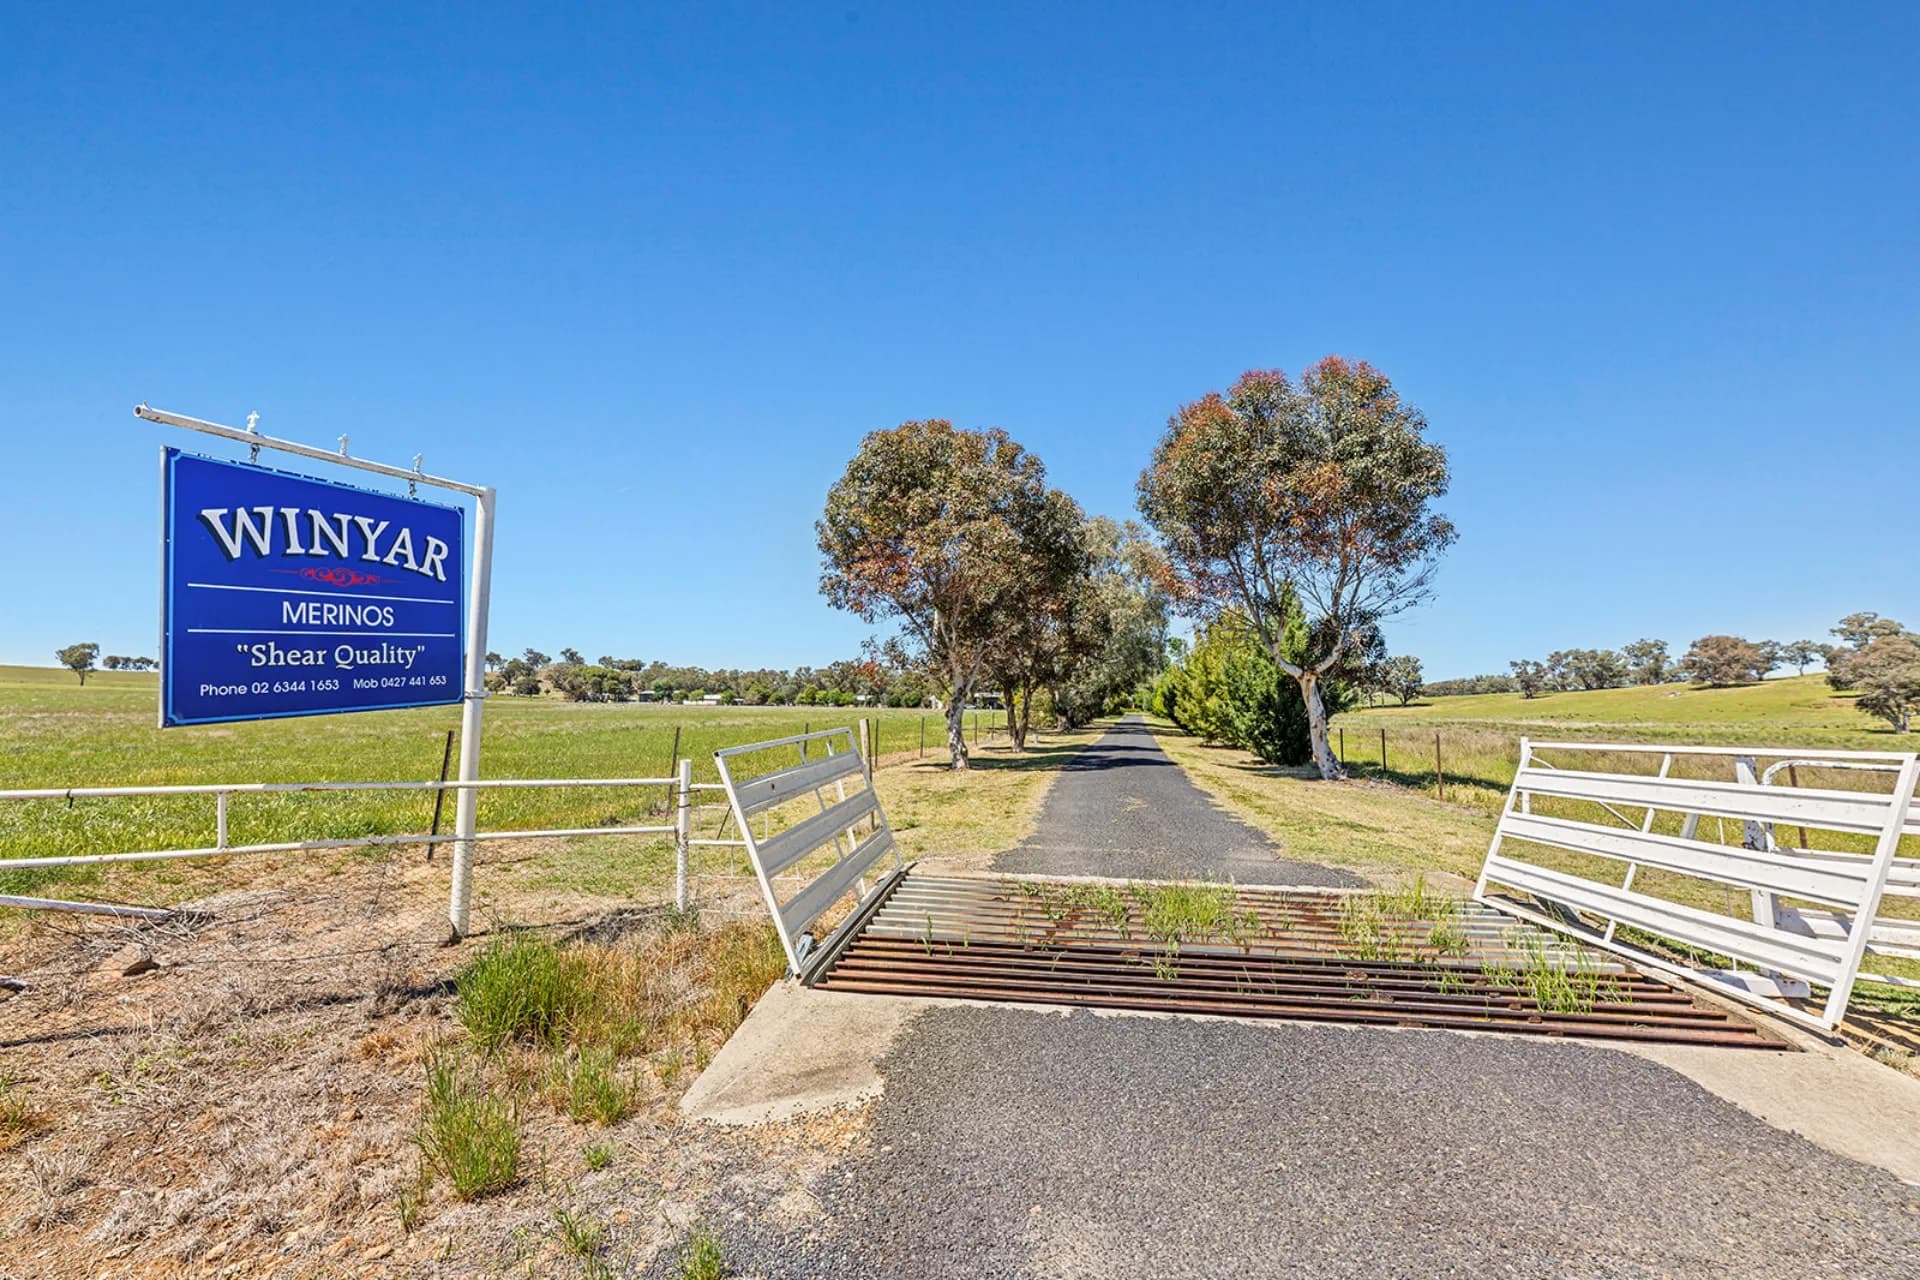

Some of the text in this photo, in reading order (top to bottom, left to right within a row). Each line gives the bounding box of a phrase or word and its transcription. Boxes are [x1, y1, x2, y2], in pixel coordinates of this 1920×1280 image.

[200, 505, 449, 582] WINYAR
[282, 601, 394, 627] MERINOS
[236, 642, 425, 670] "Shear Quality"
[200, 679, 340, 696] Phone 02 6344 1653
[353, 675, 447, 689] Mob 0427 441 653
